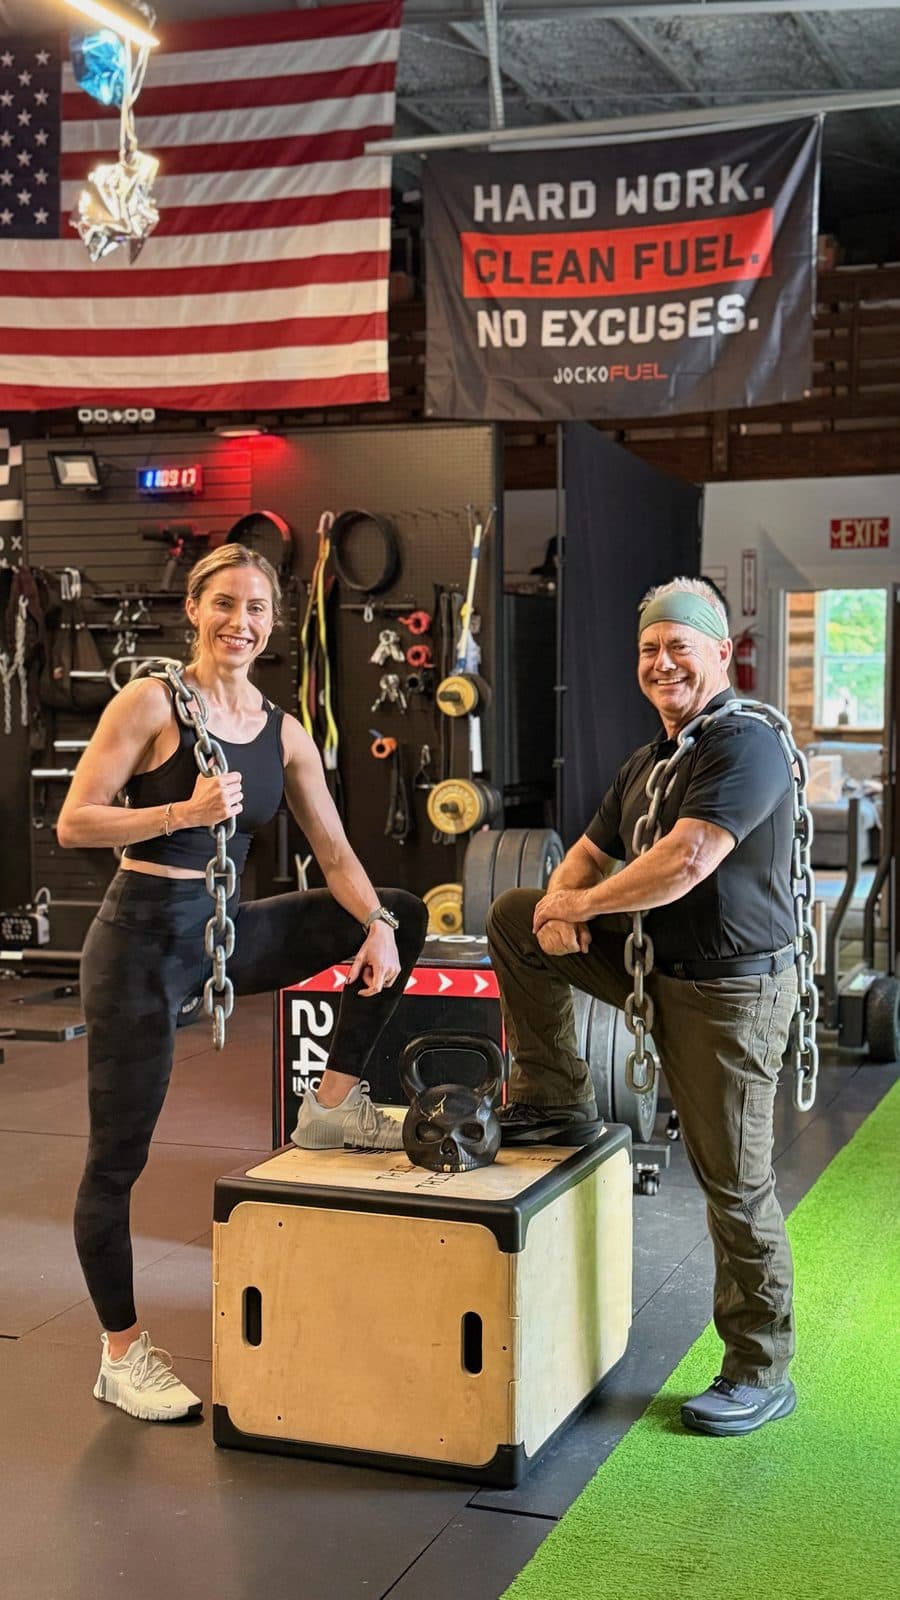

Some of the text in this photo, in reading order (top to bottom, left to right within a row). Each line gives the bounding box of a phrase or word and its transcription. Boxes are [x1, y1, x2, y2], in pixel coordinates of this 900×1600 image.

[473, 163, 766, 223] HARD WORK.
[473, 233, 761, 285] CLEAN FUEL.
[476, 293, 760, 348] NO EXCUSES.
[841, 519, 883, 547] EXIT
[291, 999, 334, 1076] 24
